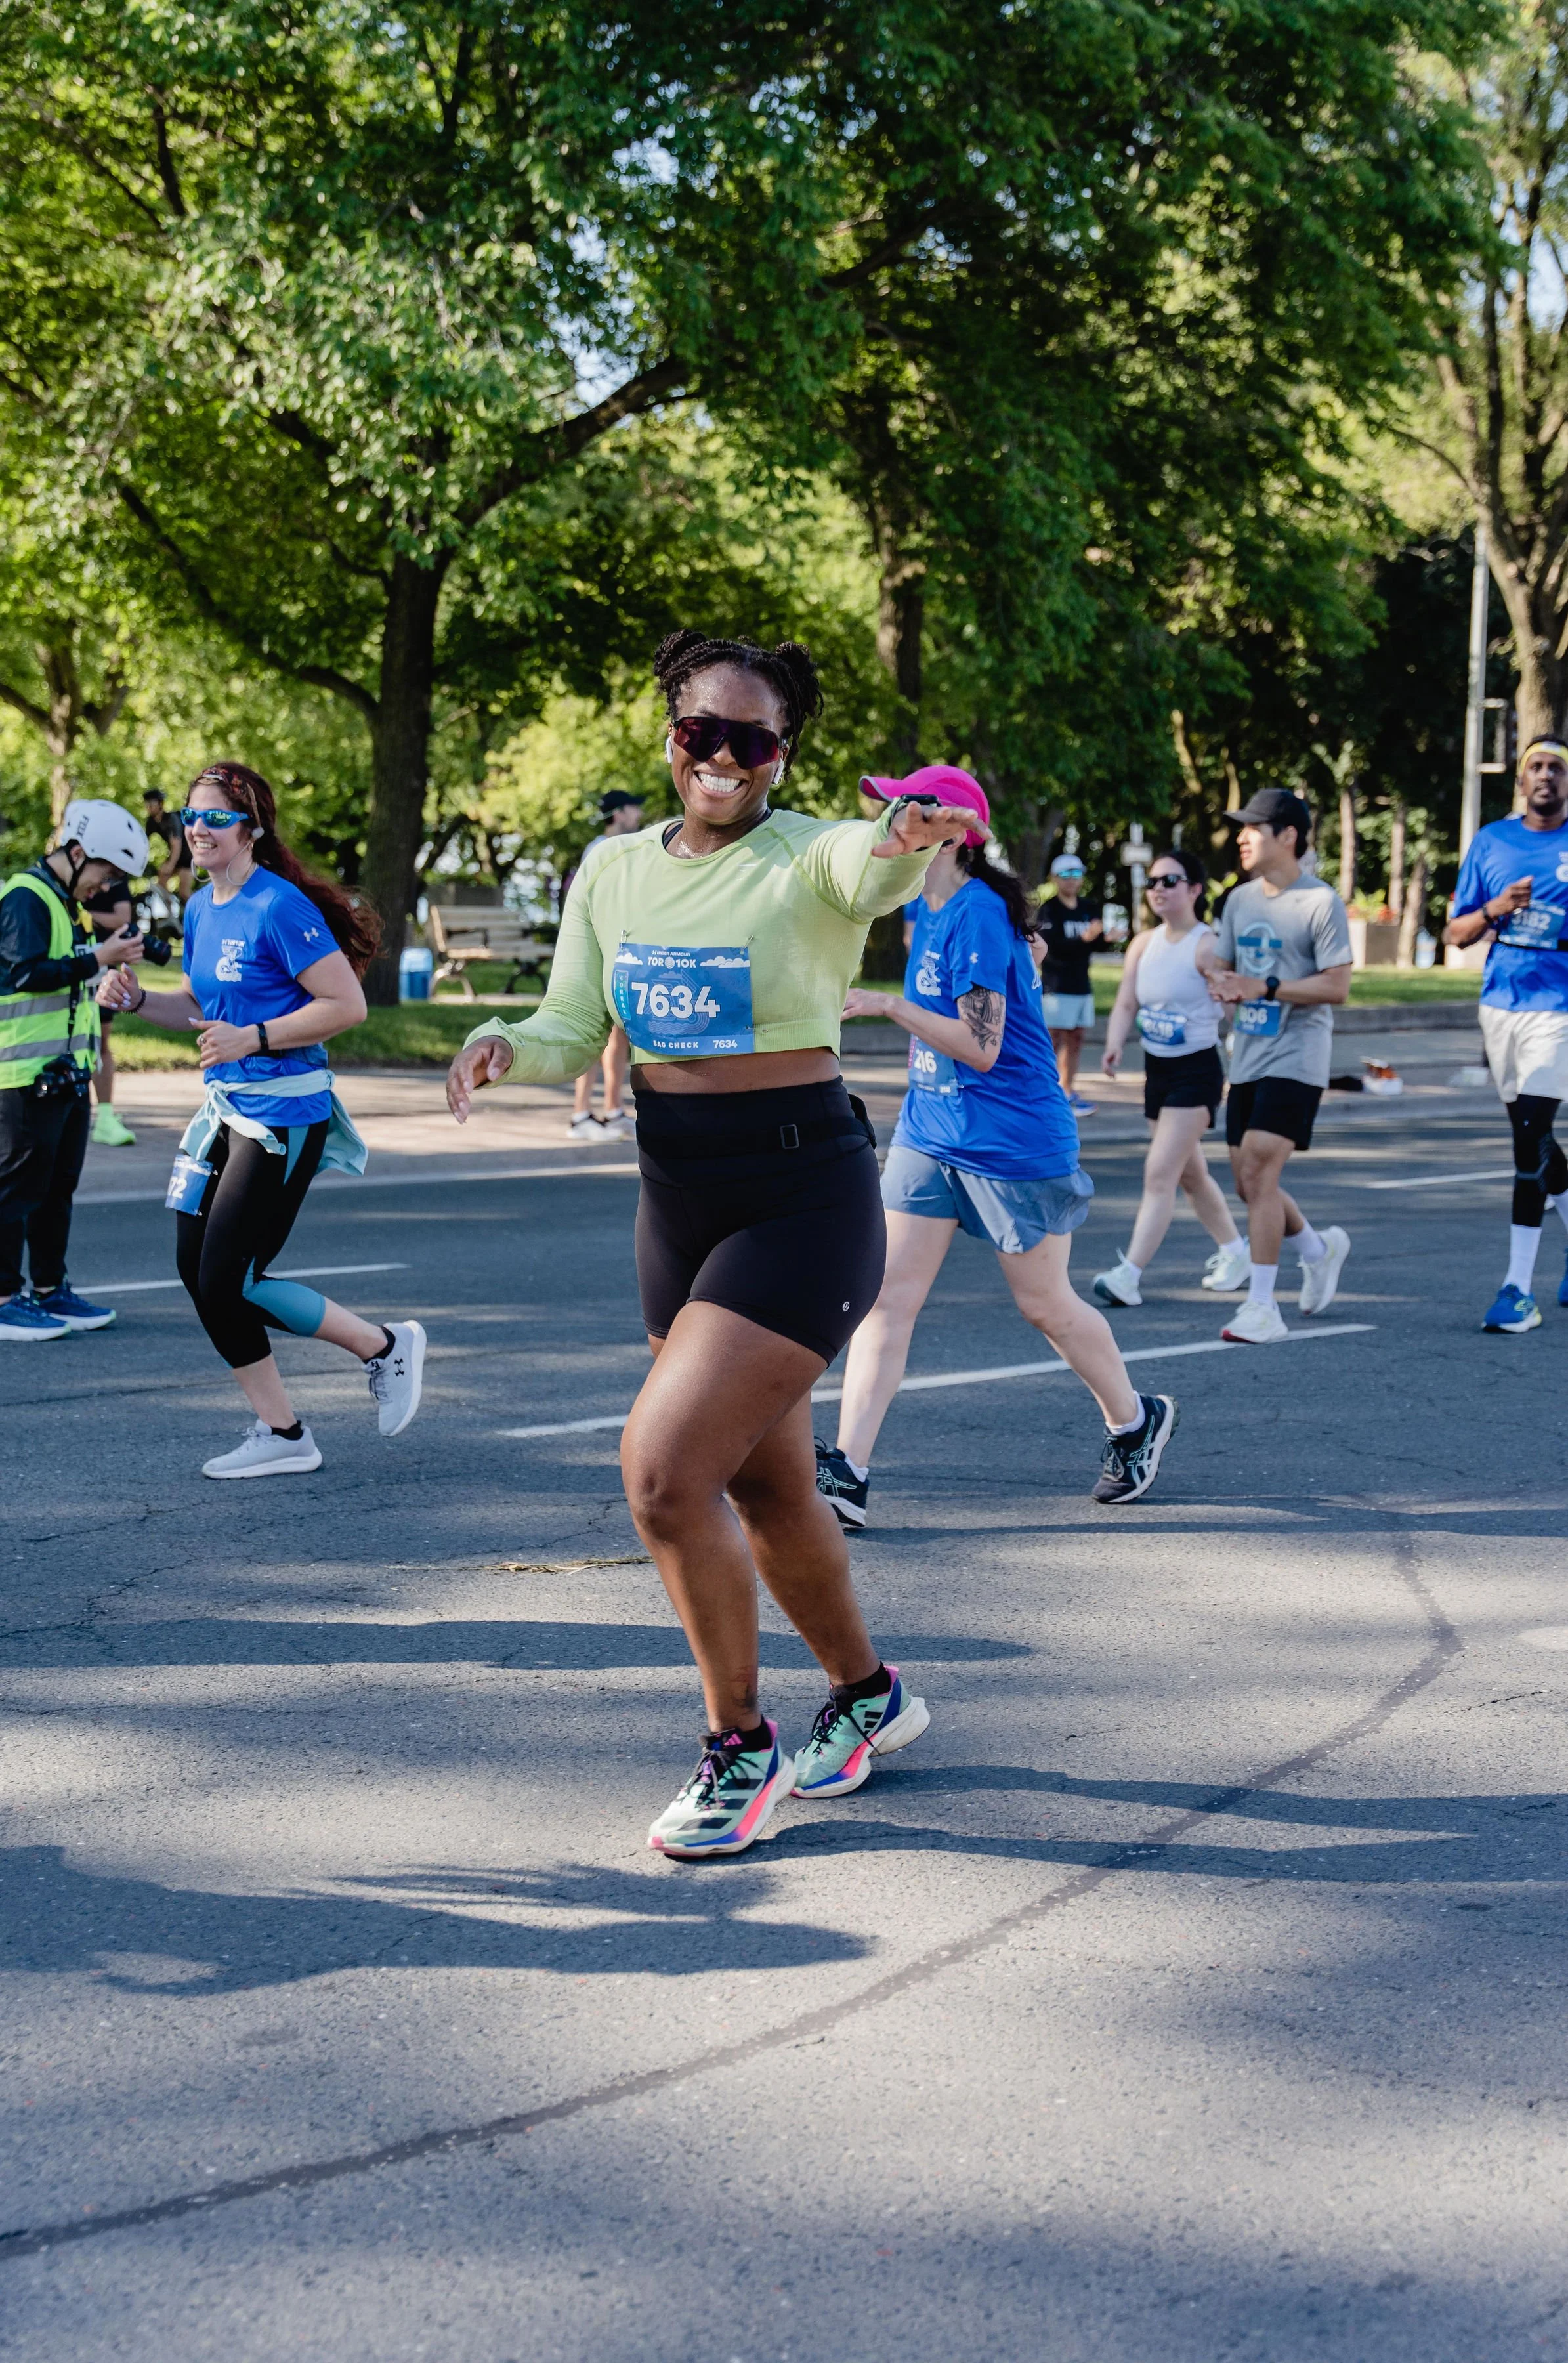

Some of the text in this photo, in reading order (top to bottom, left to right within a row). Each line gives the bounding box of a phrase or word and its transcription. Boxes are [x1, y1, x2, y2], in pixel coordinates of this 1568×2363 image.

[675, 958, 697, 968] 10K
[631, 981, 721, 1019] 7634
[713, 1039, 738, 1049] 7634
